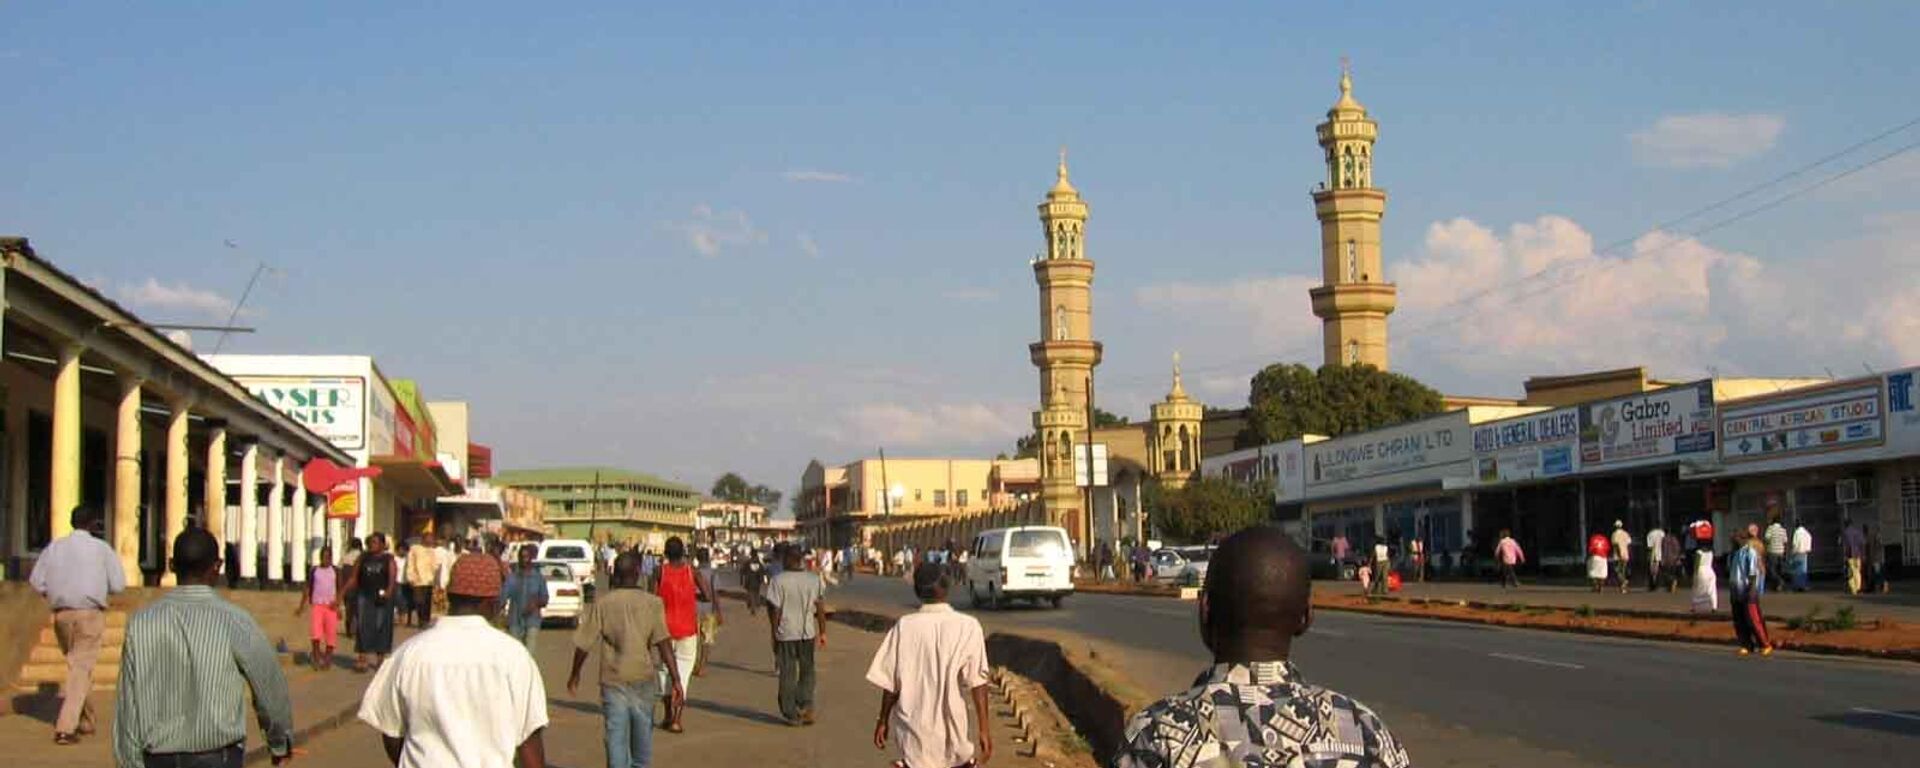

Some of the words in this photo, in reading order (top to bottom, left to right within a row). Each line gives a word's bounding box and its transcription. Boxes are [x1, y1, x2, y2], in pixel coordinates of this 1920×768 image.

[1621, 399, 1671, 422] Gabro
[1726, 414, 1774, 433] CENTRAL
[1780, 408, 1825, 425] AFRICAN
[1831, 402, 1874, 419] STUDIO
[1501, 420, 1537, 445] GENERAL
[1539, 413, 1576, 438] DEALERS
[1632, 414, 1683, 441] Limited
[1321, 443, 1375, 467] LILONGWE
[1425, 428, 1453, 450] LTD
